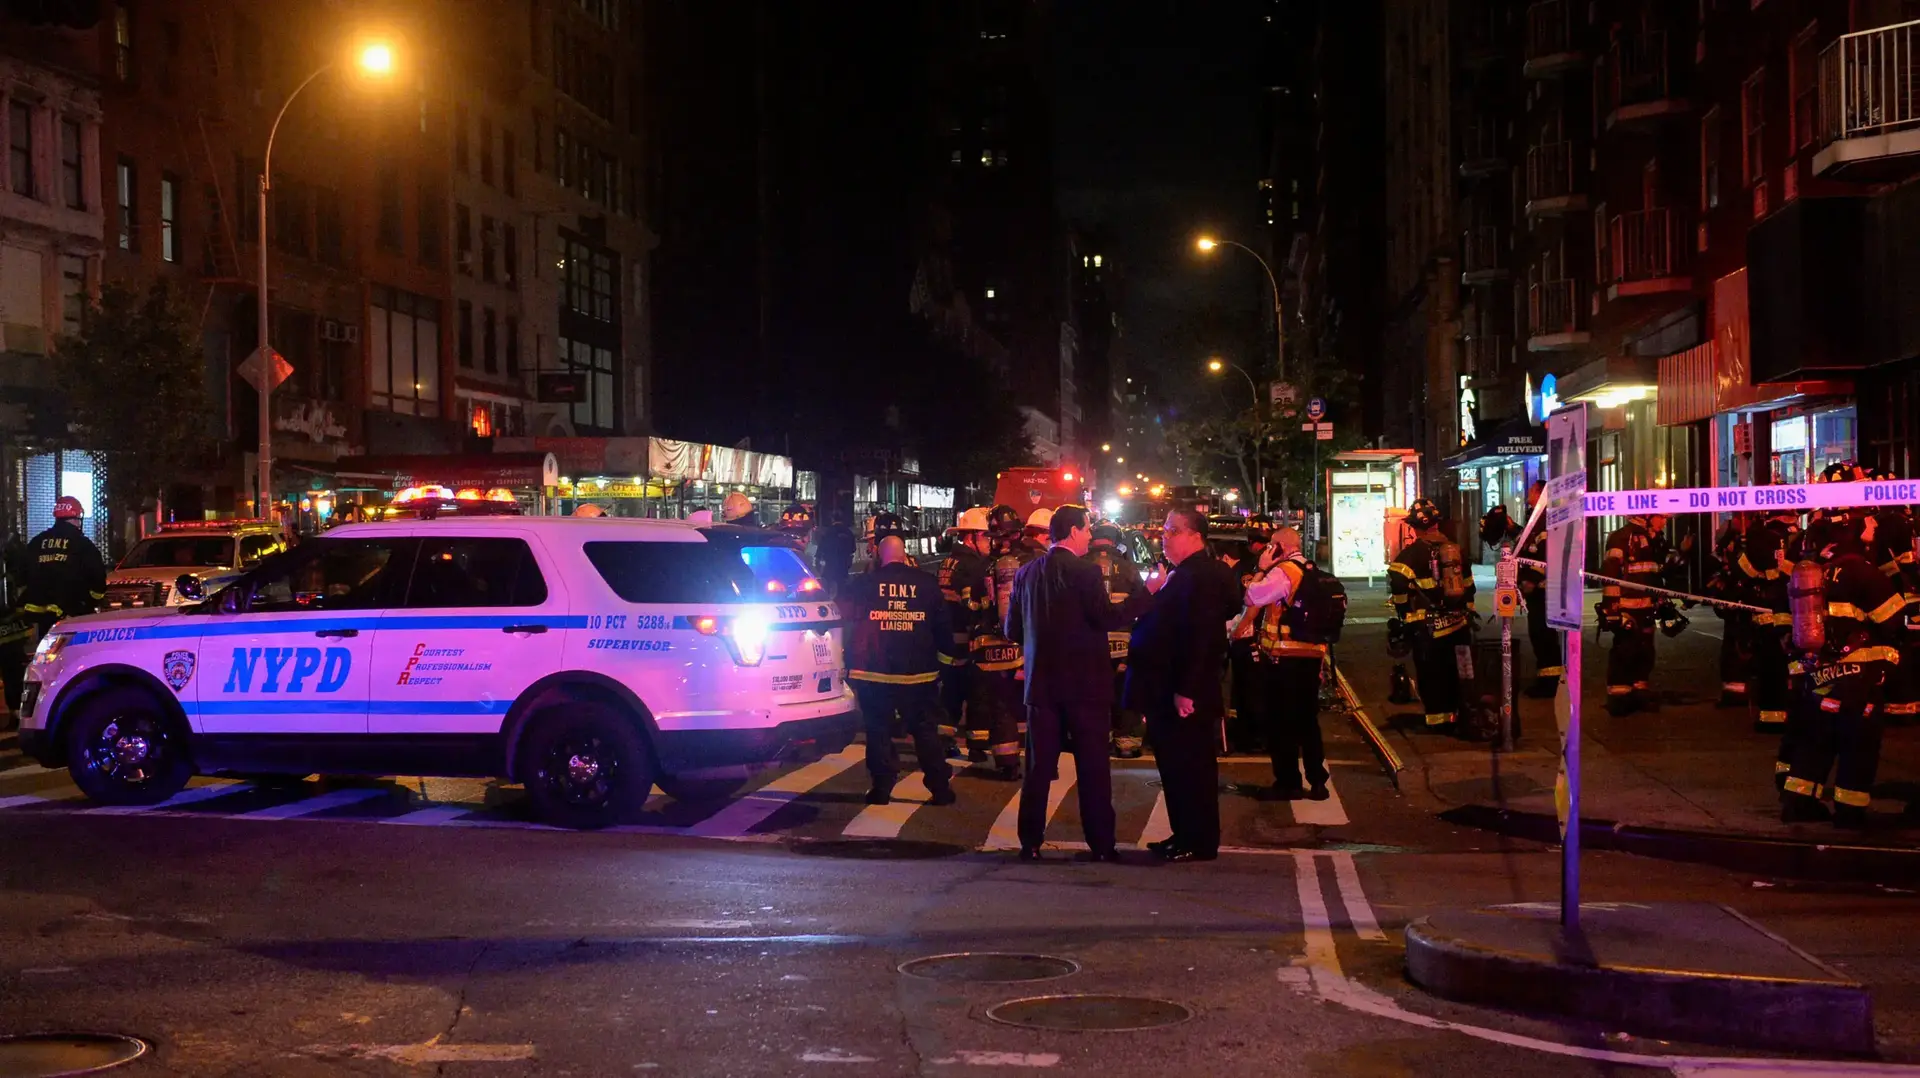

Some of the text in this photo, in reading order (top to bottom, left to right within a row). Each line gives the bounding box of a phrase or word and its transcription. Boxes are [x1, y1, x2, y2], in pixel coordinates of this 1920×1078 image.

[1508, 436, 1532, 444] FREE
[1497, 445, 1544, 453] DELIVERY
[1627, 494, 1658, 510] LINE
[1690, 492, 1710, 508] DO
[1718, 490, 1748, 506] NOT
[1755, 488, 1807, 505] CROSS
[1863, 483, 1917, 500] POLICE
[776, 605, 807, 618] NYPD
[888, 600, 907, 610] FIRE
[590, 615, 601, 629] 10
[605, 615, 627, 629] PCT
[870, 610, 926, 621] COMMISSIONER
[880, 621, 913, 631] LIAISON
[88, 627, 137, 643] POLICE
[414, 643, 465, 656] COURTESY
[587, 638, 671, 652] SUPERVISOR
[223, 647, 352, 693] NYPD
[405, 657, 492, 671] PROFESSIONALISM
[396, 672, 443, 685] RESPECT
